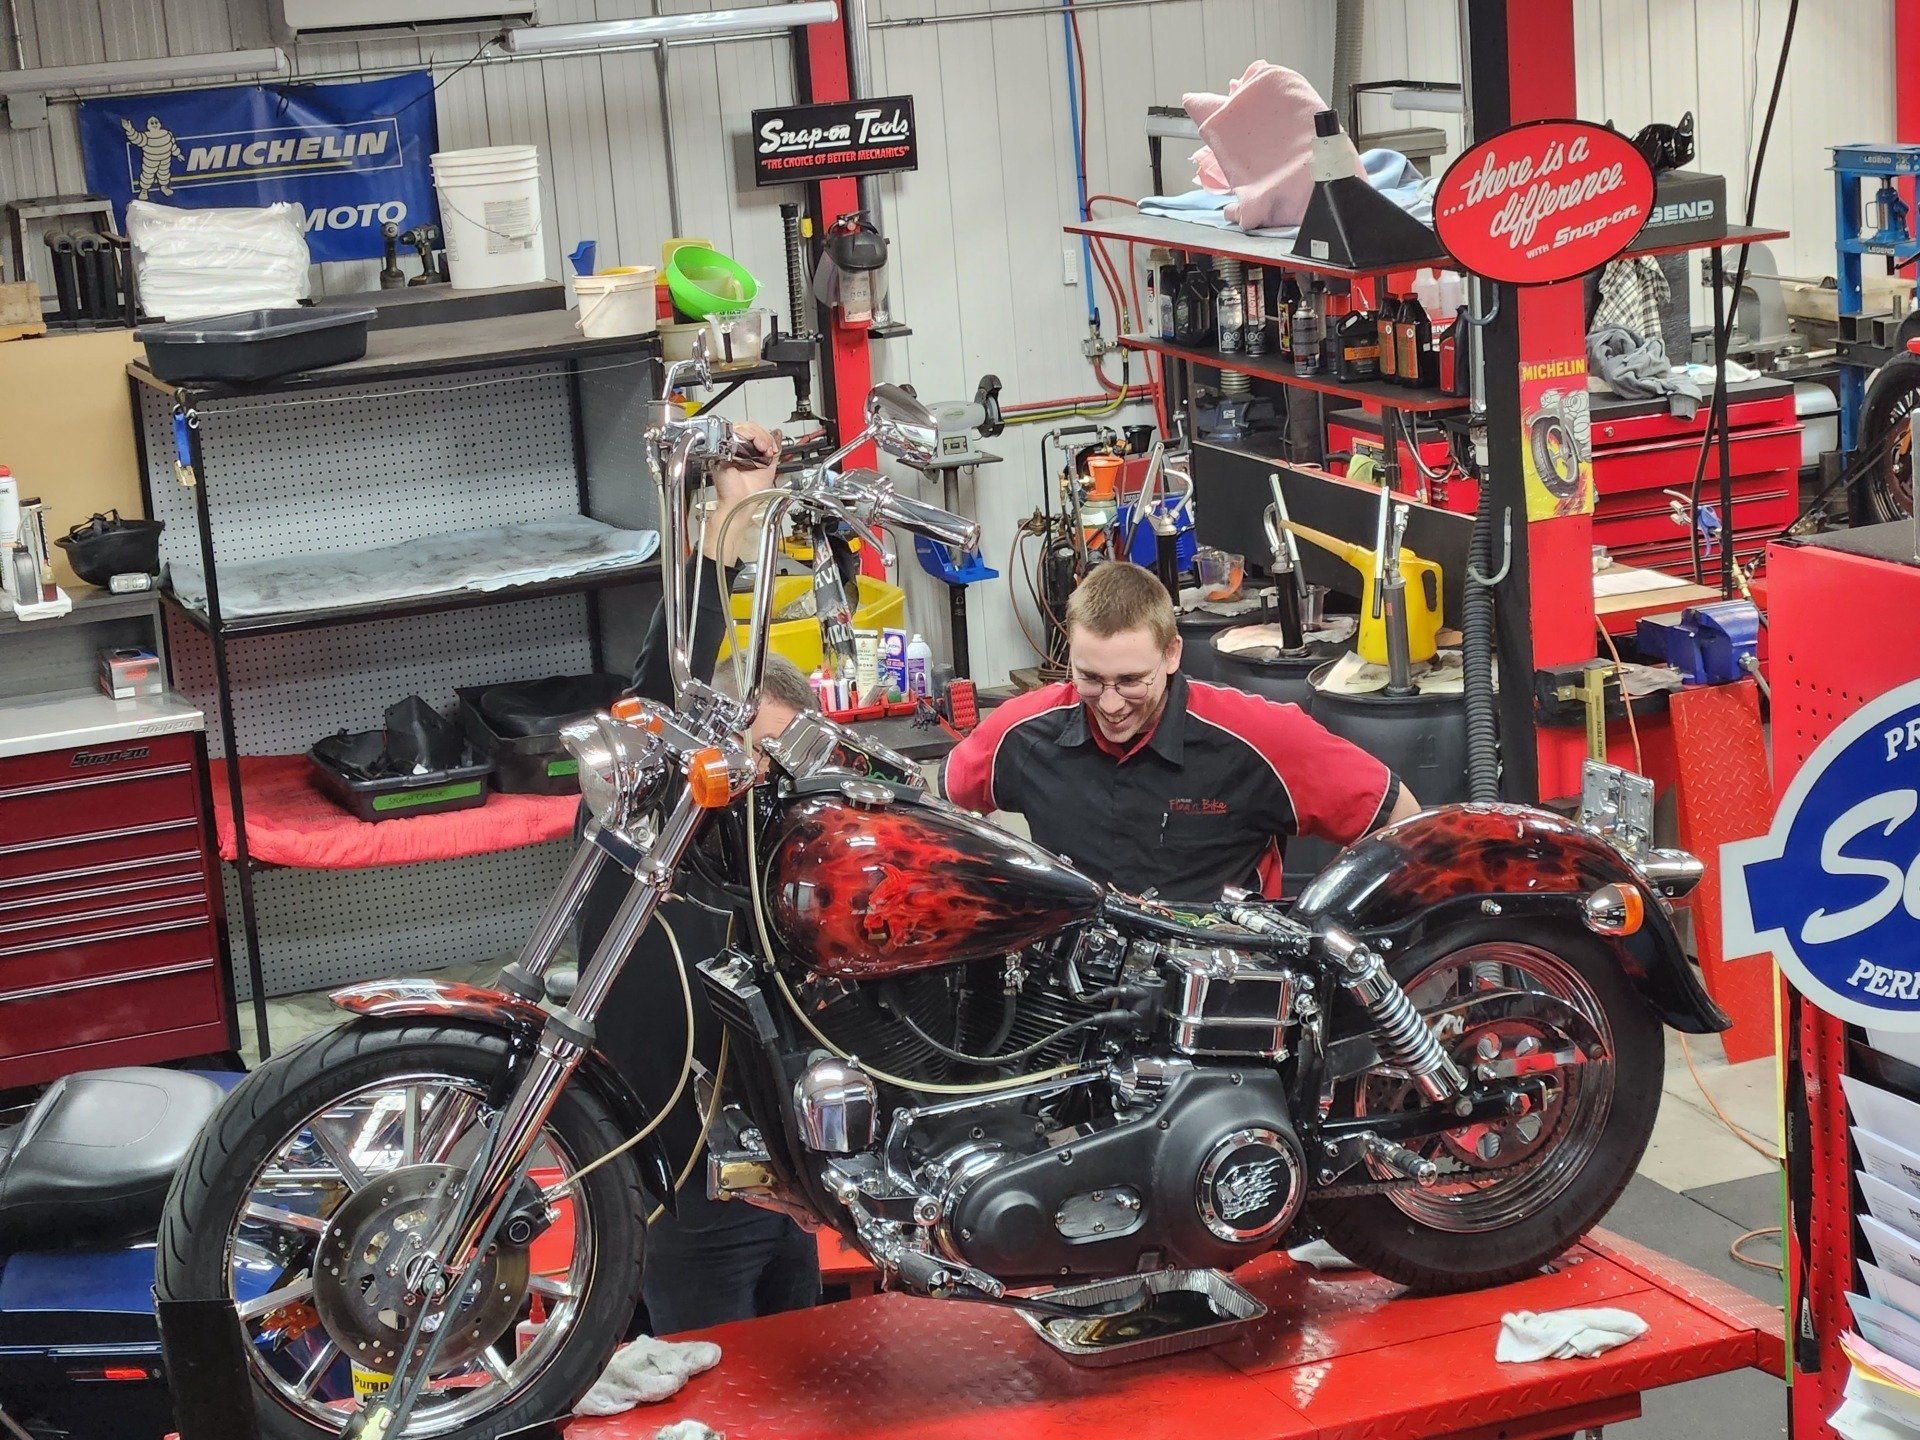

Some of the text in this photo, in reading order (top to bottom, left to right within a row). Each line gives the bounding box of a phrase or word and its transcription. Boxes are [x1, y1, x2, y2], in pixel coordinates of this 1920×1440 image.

[759, 108, 910, 154] Snap-on Tools
[186, 130, 389, 172] MICHELIN
[783, 154, 814, 169] CHOICE
[815, 153, 827, 165] OF
[827, 151, 857, 165] BETTER
[1534, 140, 1565, 180] is
[1568, 135, 1591, 163] a
[304, 200, 408, 233] MOTO
[1526, 202, 1640, 260] WITH Snap-on
[1522, 358, 1586, 383] MICHELIN
[135, 719, 195, 735] Snap-on
[70, 746, 150, 768] Snap-on
